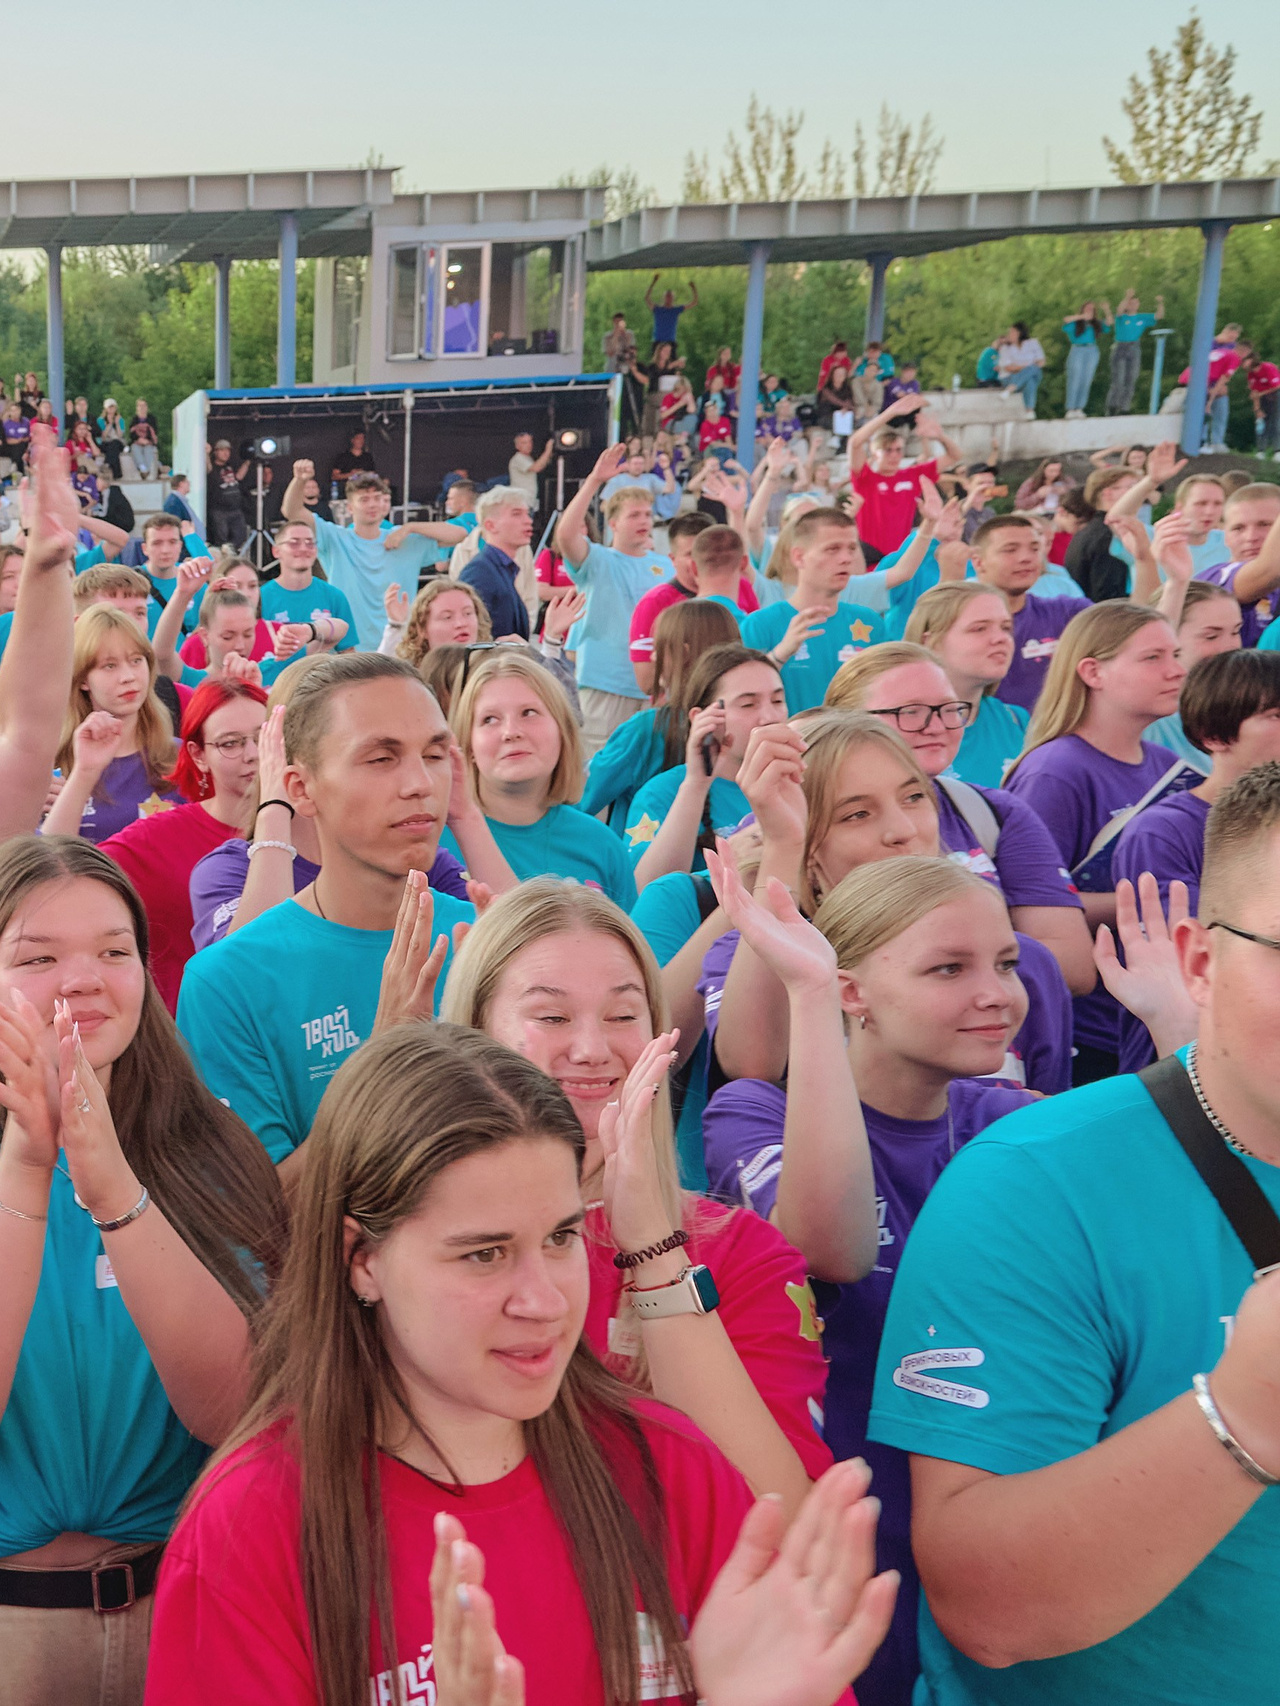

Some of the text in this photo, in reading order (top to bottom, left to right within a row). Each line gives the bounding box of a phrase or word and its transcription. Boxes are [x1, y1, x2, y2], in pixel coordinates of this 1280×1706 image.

[301, 1005, 349, 1050] ТВОЙ
[322, 1028, 360, 1058] ХОД
[927, 1352, 971, 1364] НОВЫХ
